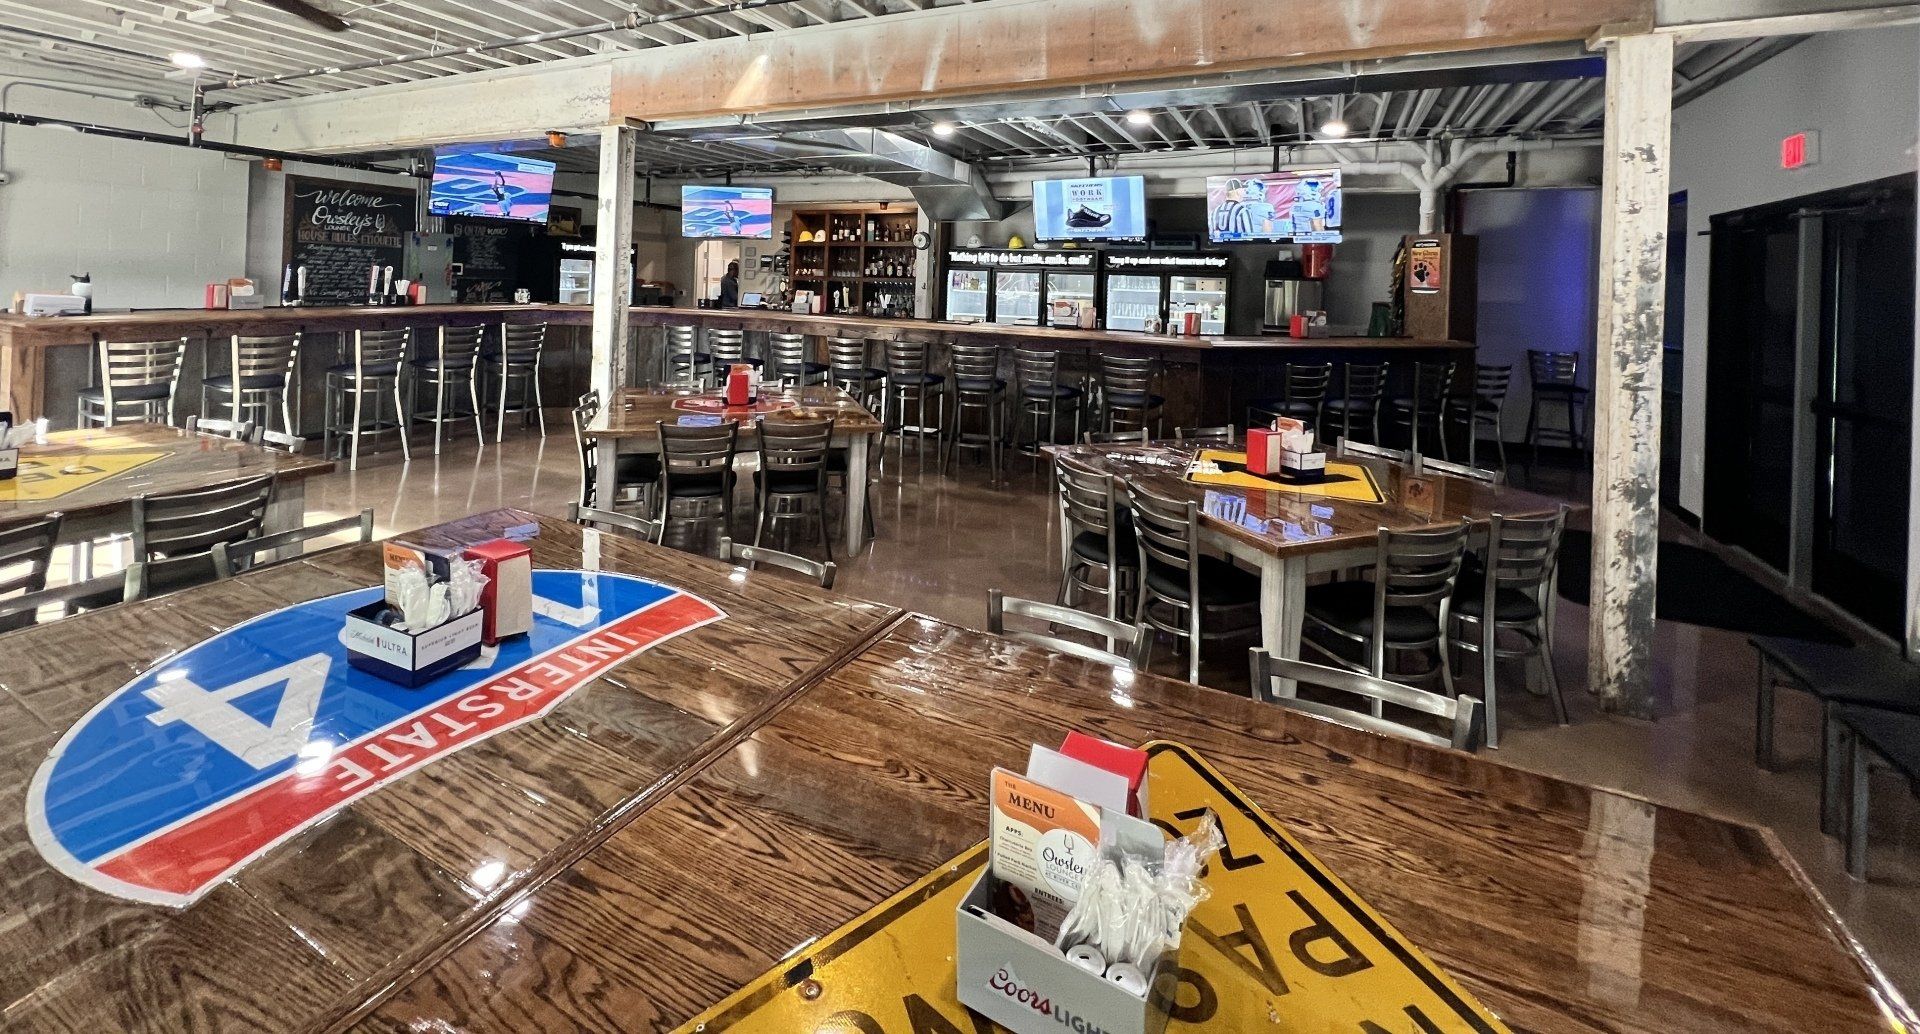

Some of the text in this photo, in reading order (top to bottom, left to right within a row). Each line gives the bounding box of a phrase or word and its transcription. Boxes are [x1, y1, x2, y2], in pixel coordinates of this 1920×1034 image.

[991, 253, 998, 262] to
[999, 253, 1008, 262] do
[1009, 253, 1022, 263] but
[382, 640, 408, 657] ULTRA
[325, 630, 640, 792] INTERSTATE
[1005, 781, 1016, 790] THE
[1009, 792, 1055, 819] MENU
[1045, 862, 1080, 881] LOUNGE
[990, 968, 1052, 1015] Coors
[1054, 1005, 1114, 1034] LIGH
